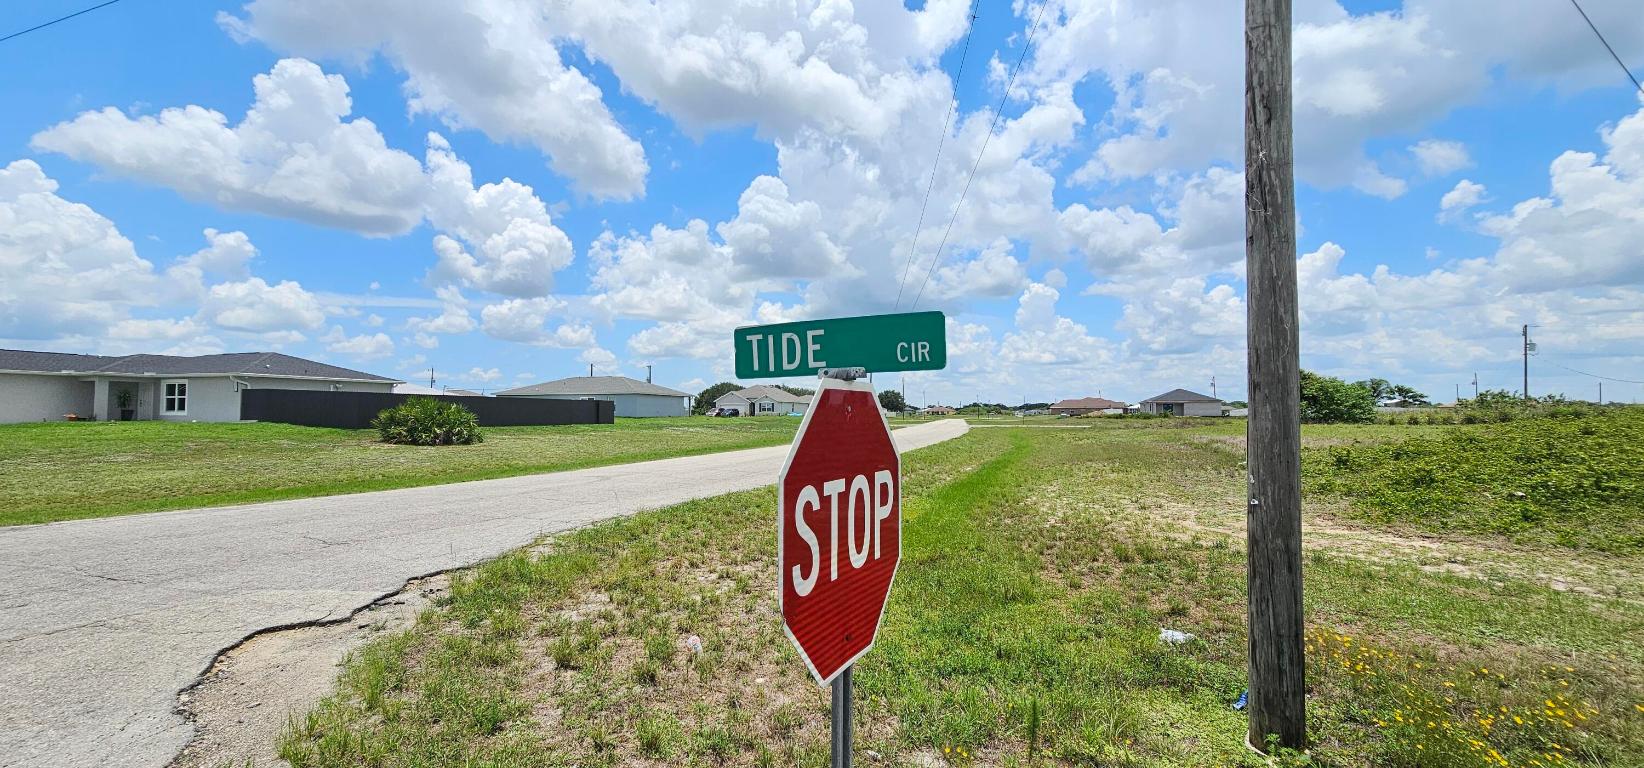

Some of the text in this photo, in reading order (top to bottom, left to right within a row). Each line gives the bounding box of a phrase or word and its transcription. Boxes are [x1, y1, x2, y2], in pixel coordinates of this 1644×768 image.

[746, 329, 930, 372] TIDE CIR
[792, 469, 894, 597] STOP
